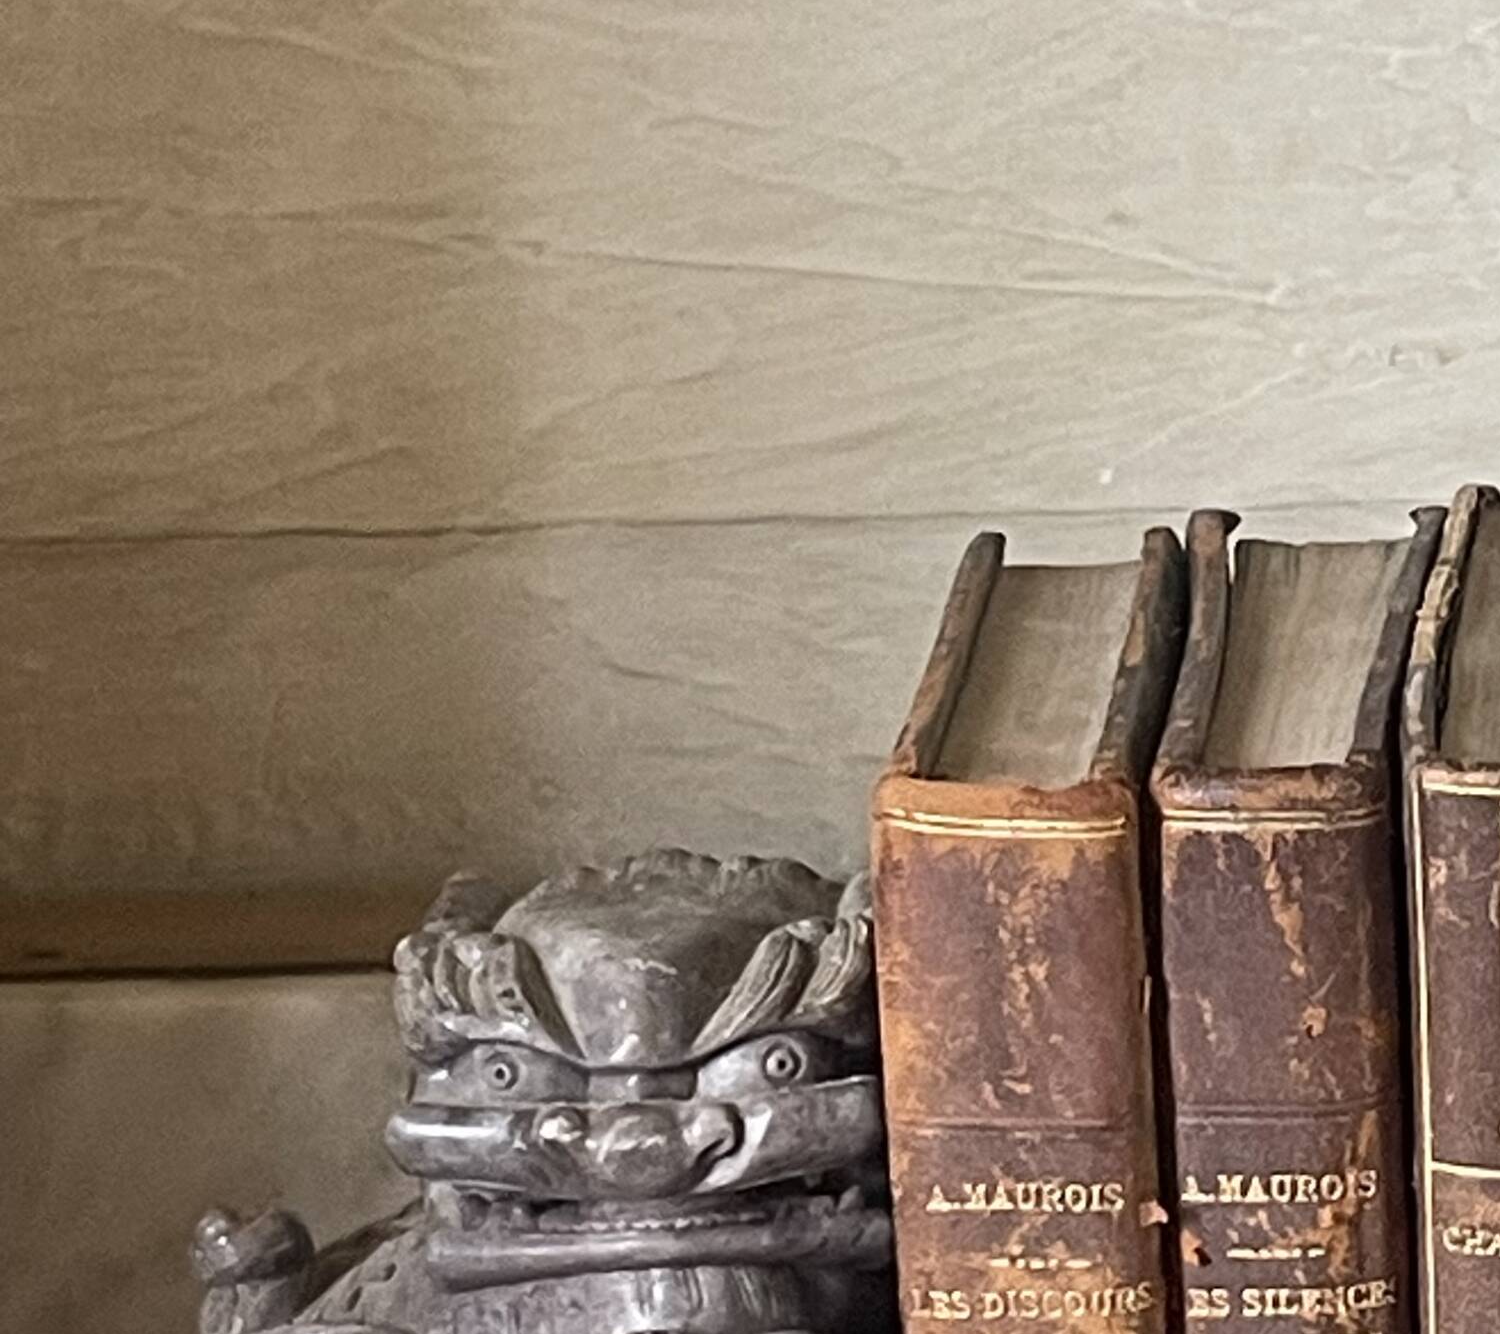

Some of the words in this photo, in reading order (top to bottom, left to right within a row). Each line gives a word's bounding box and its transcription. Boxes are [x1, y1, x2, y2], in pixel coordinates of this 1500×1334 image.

[926, 1182, 1125, 1213] A.MAUROIS
[1181, 1170, 1377, 1203] A.MAUROIS
[910, 1288, 971, 1319] LES
[982, 1281, 1154, 1319] DISCOURS
[1185, 1287, 1231, 1318] ES
